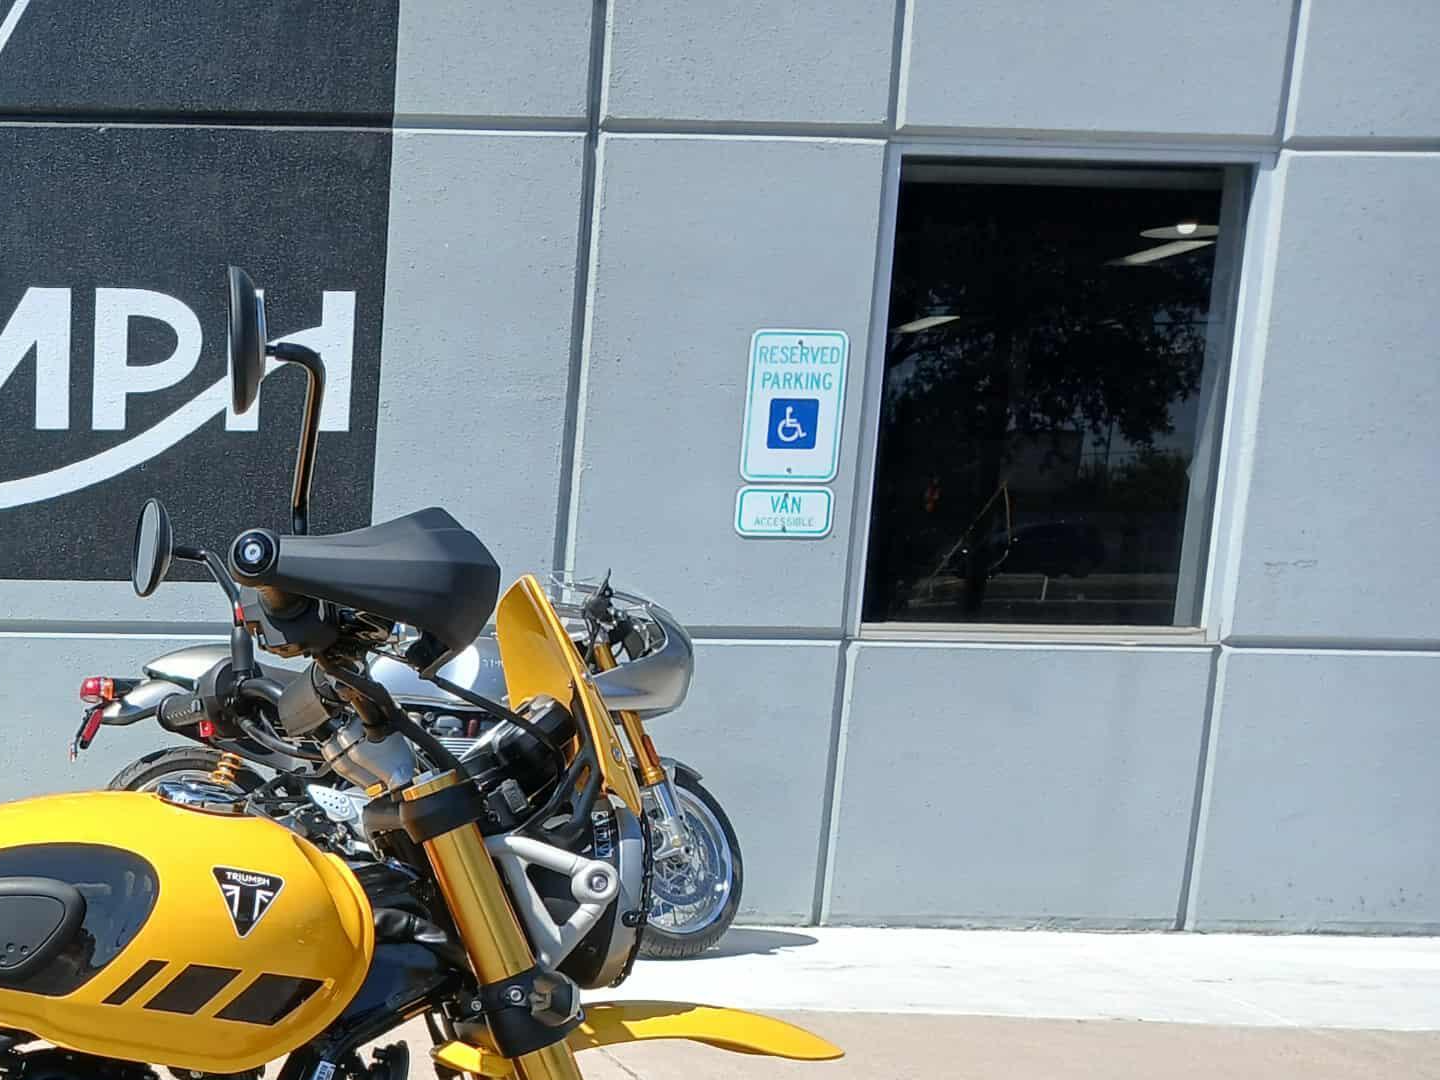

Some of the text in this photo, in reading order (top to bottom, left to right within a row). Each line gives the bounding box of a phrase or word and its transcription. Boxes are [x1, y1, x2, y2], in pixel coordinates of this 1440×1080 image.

[759, 345, 841, 364] RESERVED
[761, 372, 832, 390] PARKING
[770, 495, 802, 513] VAN
[753, 515, 815, 528] ACCESSIBLE
[225, 871, 270, 887] TRIUMPH
